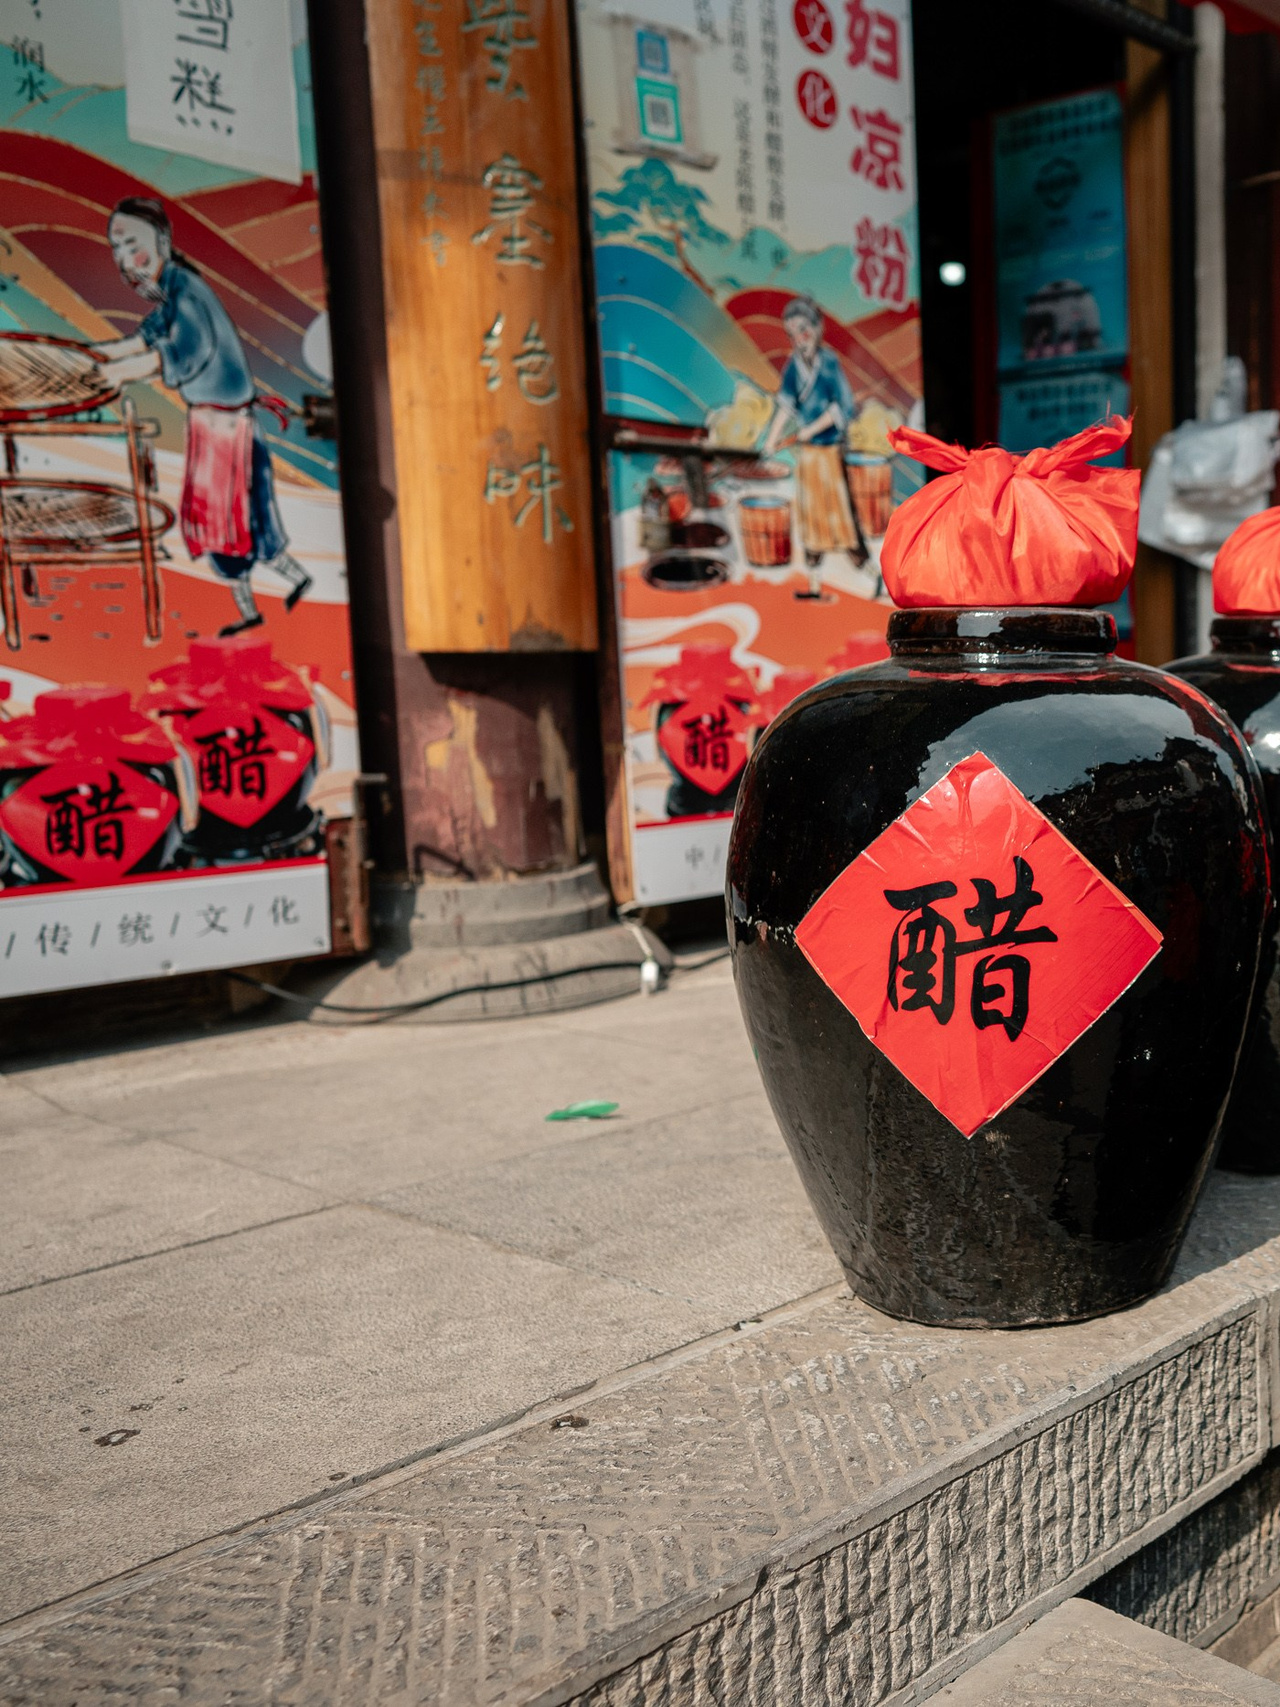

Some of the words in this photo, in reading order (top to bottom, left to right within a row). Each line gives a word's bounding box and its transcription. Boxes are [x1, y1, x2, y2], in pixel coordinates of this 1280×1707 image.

[195, 716, 276, 801] 醋
[682, 704, 733, 773] 醋
[40, 769, 136, 861] 醋
[883, 855, 1058, 1043] 醋
